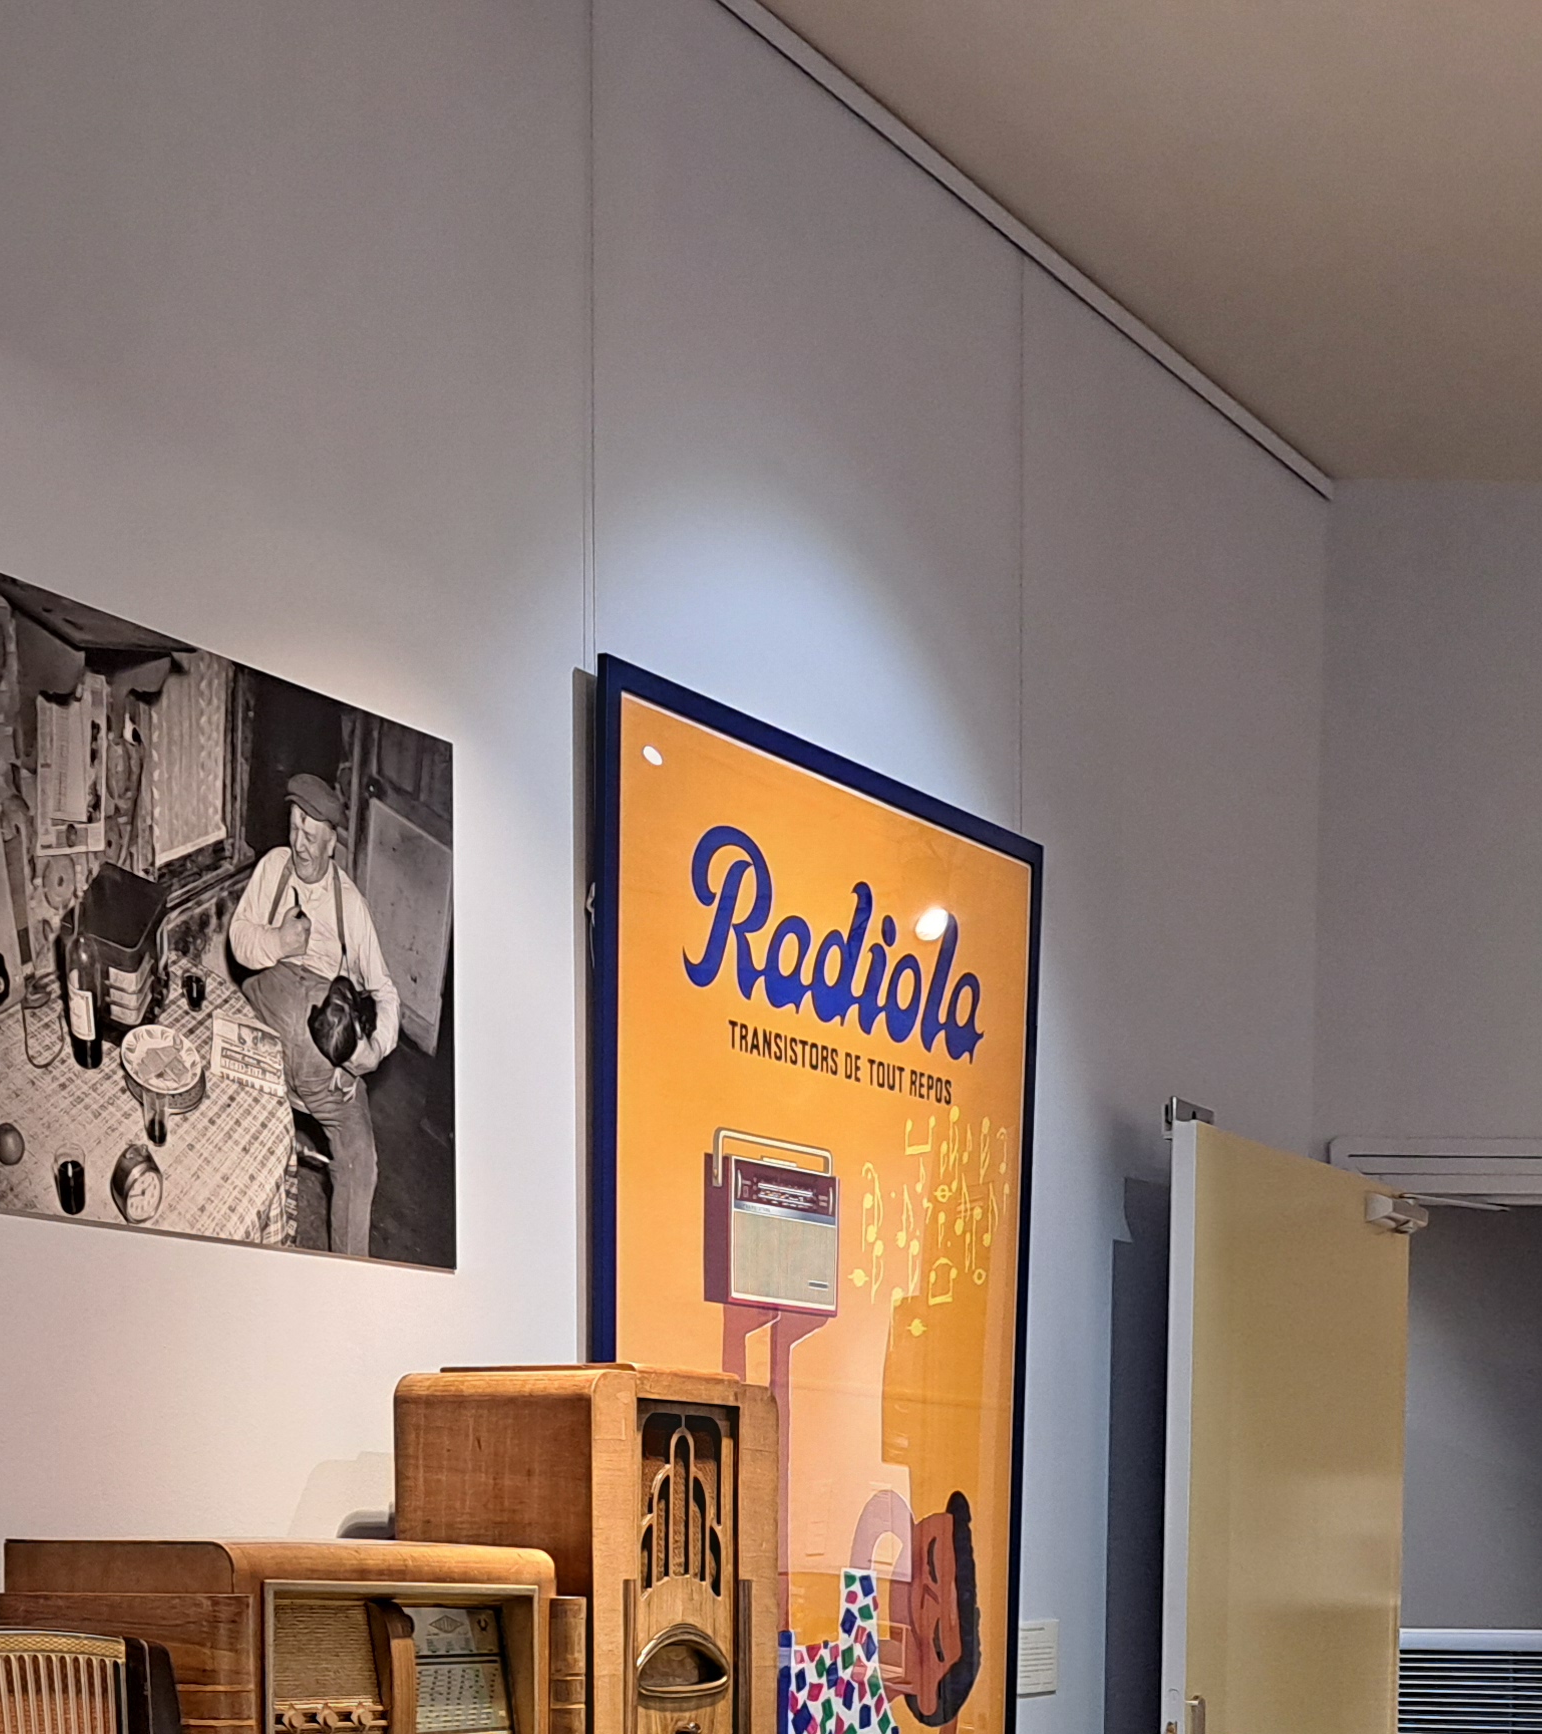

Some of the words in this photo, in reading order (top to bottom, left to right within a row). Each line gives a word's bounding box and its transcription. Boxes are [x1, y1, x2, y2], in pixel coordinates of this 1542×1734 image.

[682, 825, 984, 1065] Radiola
[728, 1019, 838, 1076] TRANSISTORS
[844, 1052, 861, 1082] DE
[868, 1058, 905, 1093] TOUT
[909, 1069, 952, 1105] REPOS
